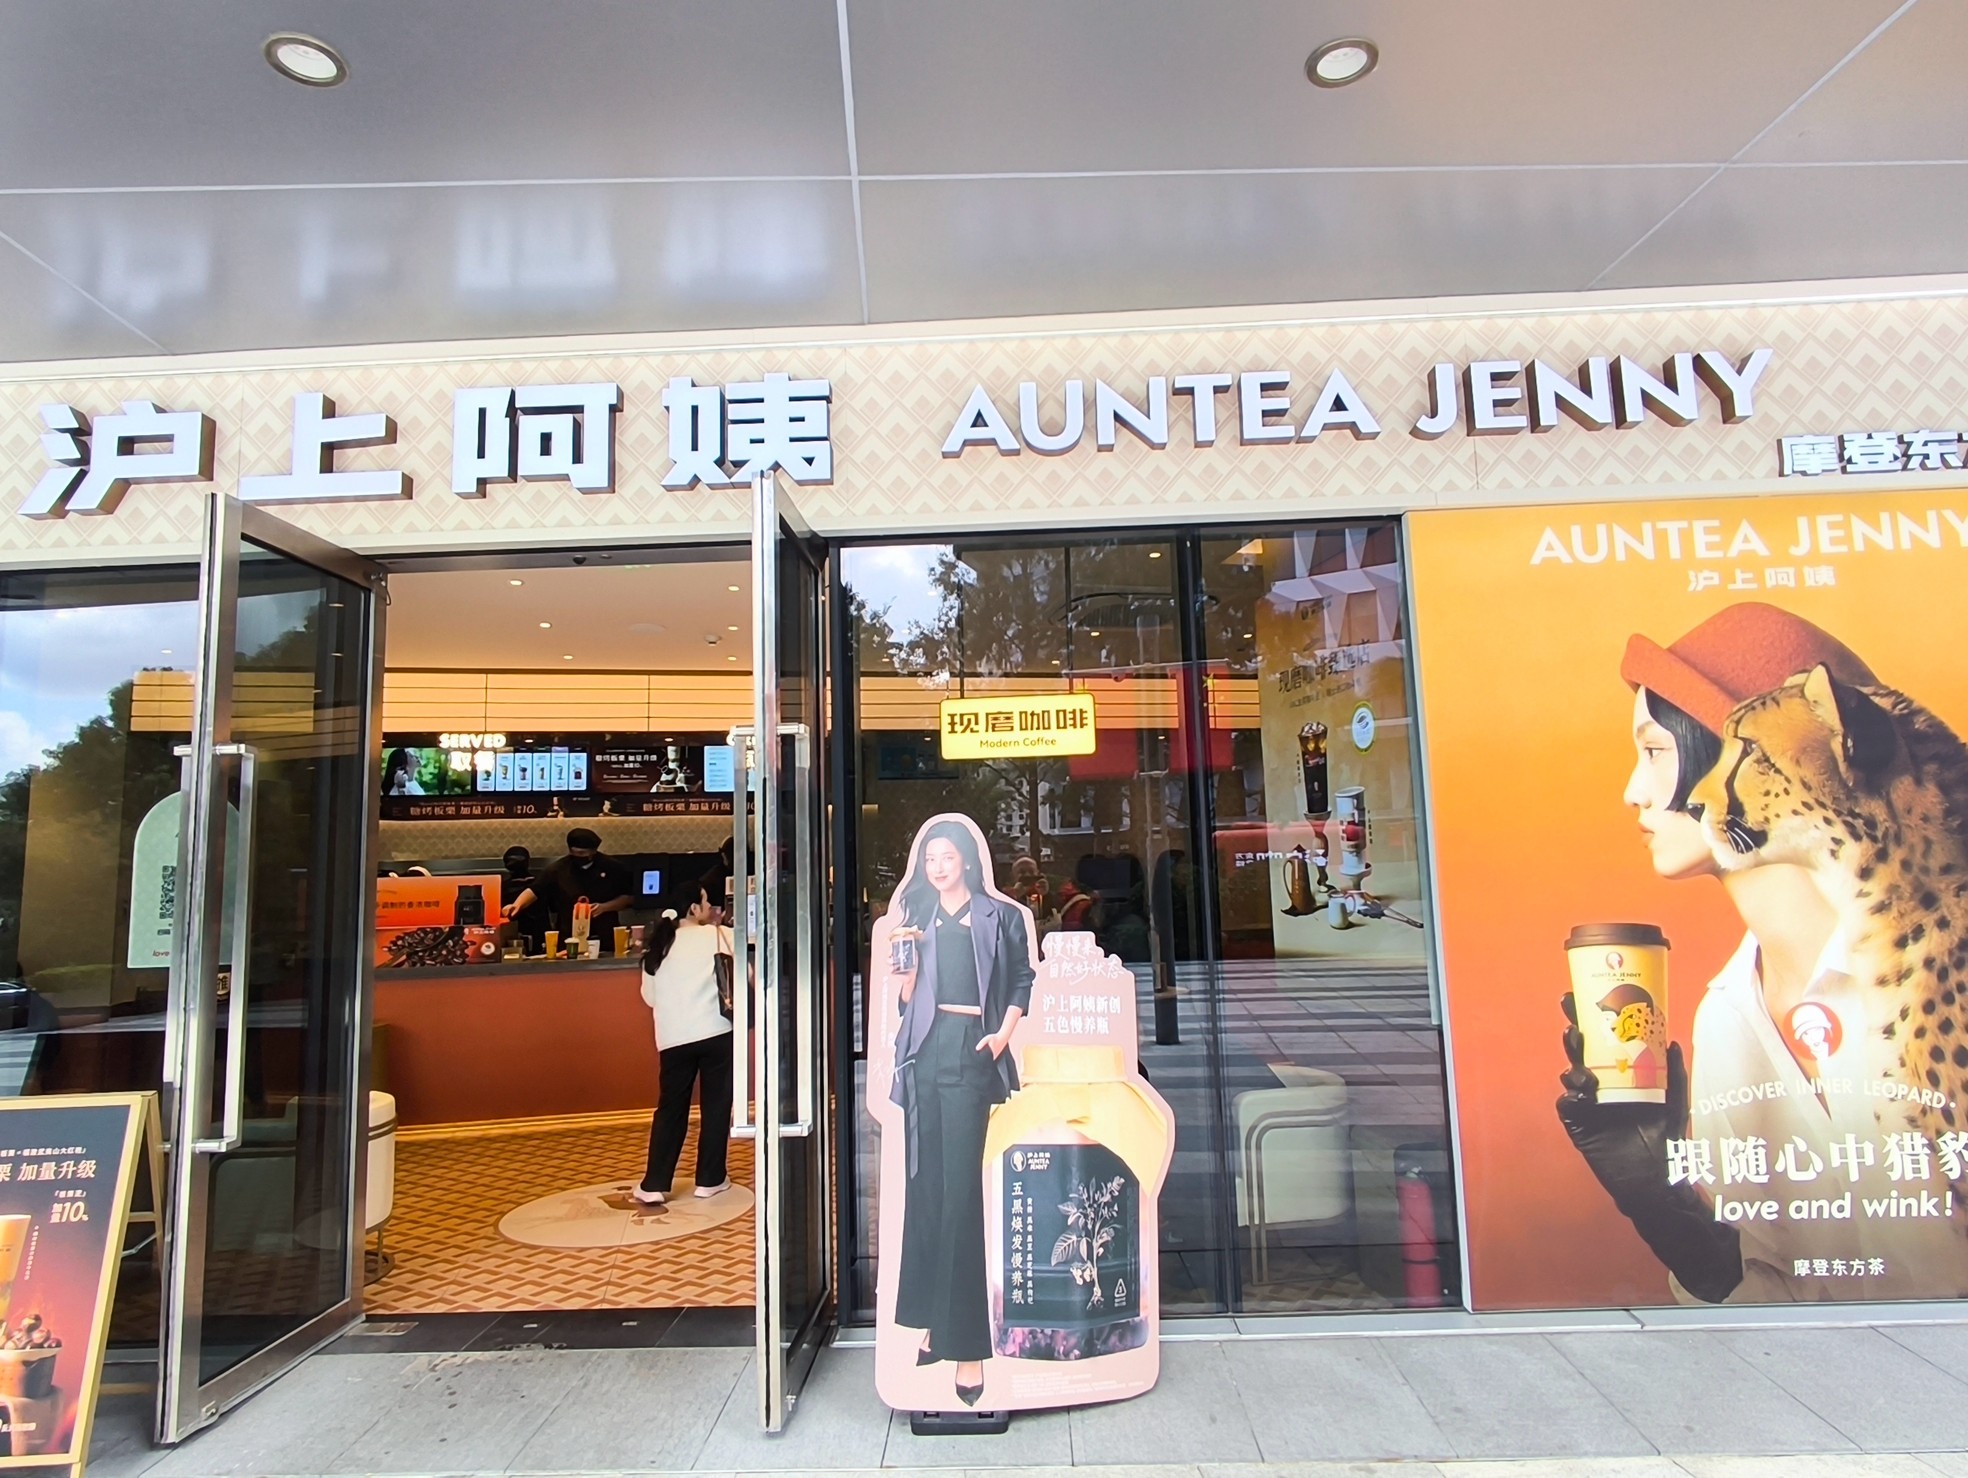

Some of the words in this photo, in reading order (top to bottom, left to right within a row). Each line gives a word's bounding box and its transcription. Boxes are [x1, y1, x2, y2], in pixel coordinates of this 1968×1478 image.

[941, 367, 1382, 458] AUNTEA
[1413, 349, 1774, 440] JENNY
[18, 372, 833, 520] 沪上阿姨
[1777, 429, 1968, 477] 摩登东
[1529, 518, 1770, 565] AUNTEA
[1687, 565, 1836, 591] 沪上阿姨
[948, 709, 1088, 734] 现磨咖啡
[440, 733, 506, 748] SERVED
[979, 739, 1020, 748] Modern
[1023, 737, 1057, 747] Coffee
[1041, 959, 1124, 984] 自然好状态
[1043, 994, 1121, 1014] 沪上阿姨新创
[1043, 1015, 1109, 1034] 五色慢养瓶
[1700, 1081, 1787, 1115] DISCOVER
[1796, 1078, 1852, 1094] INNER
[1864, 1082, 1946, 1109] LEOPARD
[17, 1160, 96, 1181] 加量升级
[1714, 1197, 1780, 1221] love
[1788, 1194, 1852, 1219] and
[1862, 1191, 1954, 1218] wink!
[1011, 1181, 1024, 1304] 五黑焕发慢养瓶
[1794, 1258, 1885, 1277] 摩登东方茶
